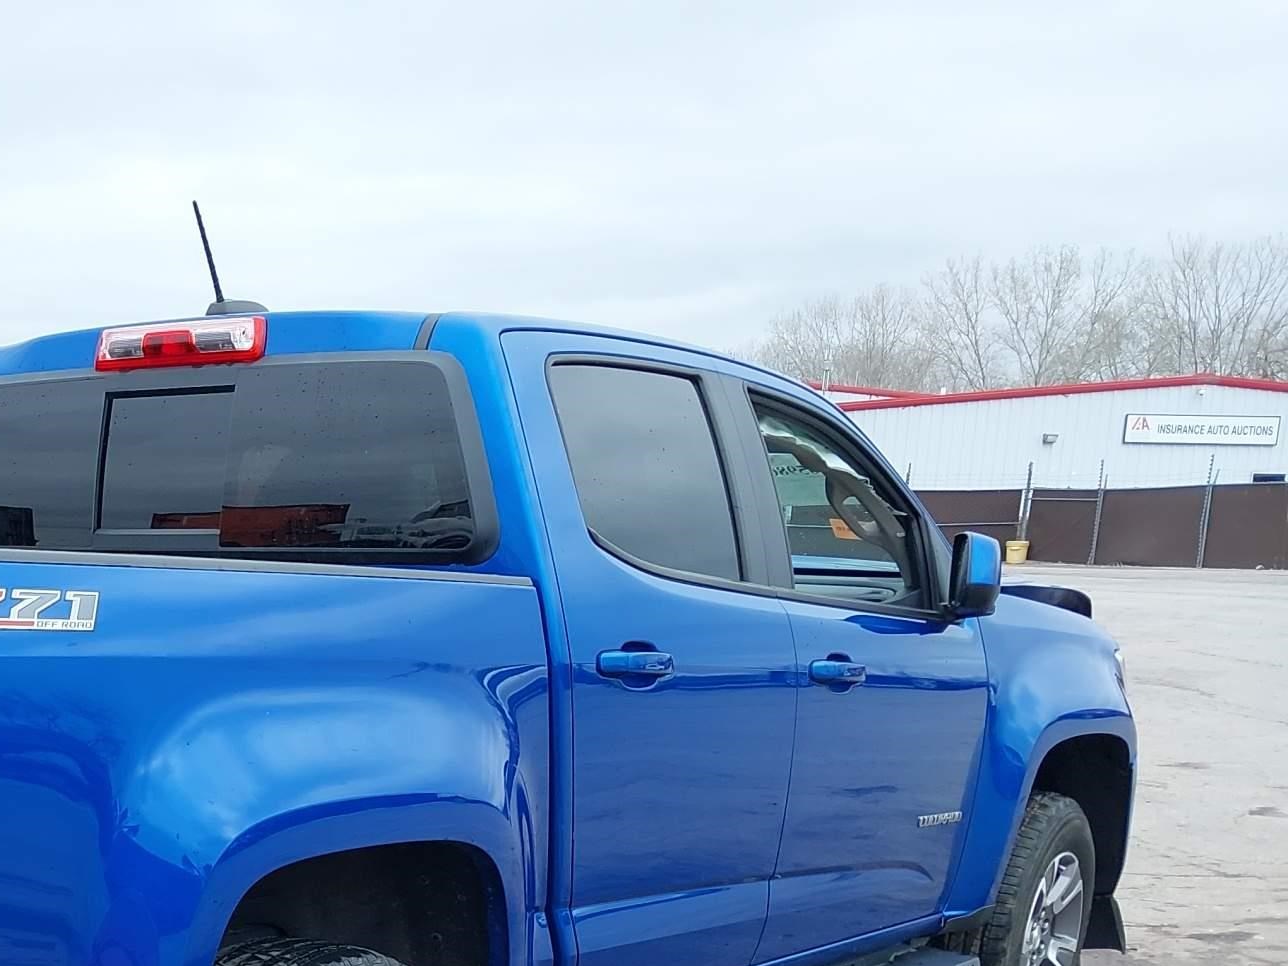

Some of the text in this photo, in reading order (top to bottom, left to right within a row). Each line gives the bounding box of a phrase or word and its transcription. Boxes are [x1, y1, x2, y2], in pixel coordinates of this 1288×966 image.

[1157, 423, 1205, 436] INSURANCE
[1206, 424, 1230, 436] AUTO
[1231, 424, 1274, 437] AUCTIONS
[36, 620, 93, 629] OFF ROAD
